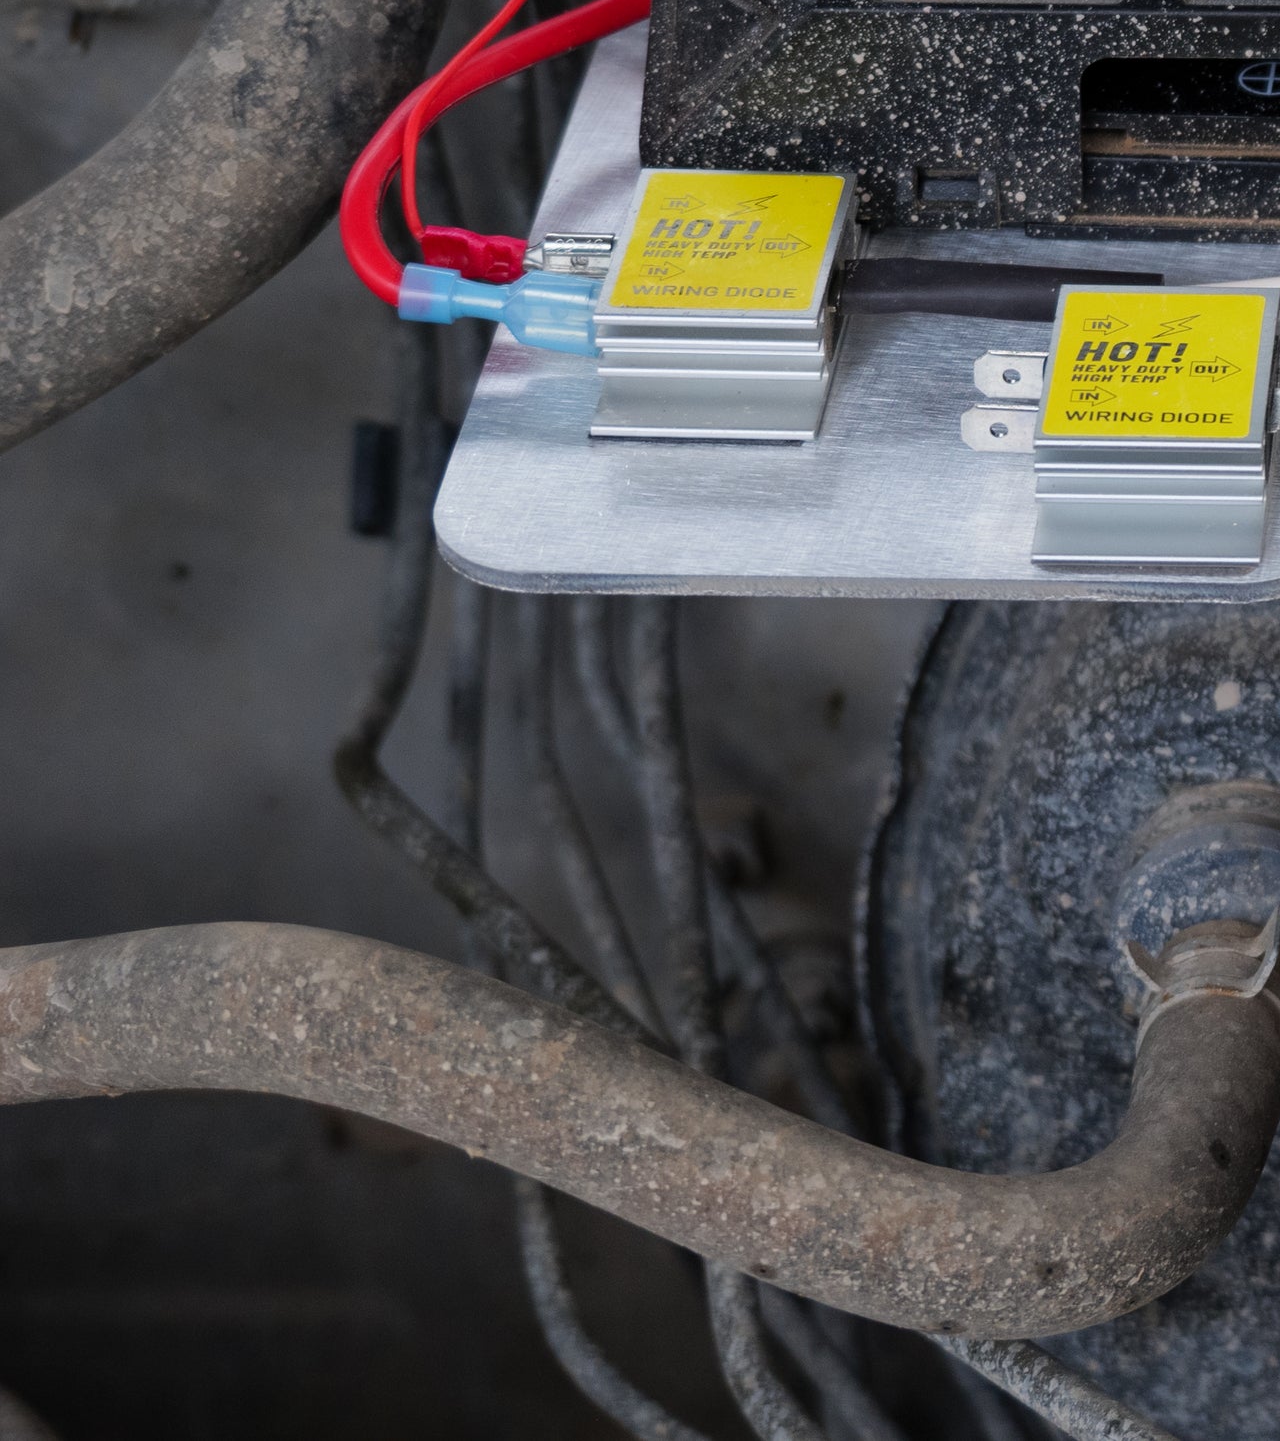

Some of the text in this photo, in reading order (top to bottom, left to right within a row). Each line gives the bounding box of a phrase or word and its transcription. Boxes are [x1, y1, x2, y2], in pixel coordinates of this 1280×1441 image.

[669, 201, 689, 209] IN
[650, 218, 762, 240] HOT!
[645, 240, 756, 250] HEAVY DUTY
[765, 242, 800, 251] OUT
[642, 250, 737, 259] HIGH TEMP
[648, 267, 669, 276] IN
[632, 285, 798, 299] WIRING DIODE
[1092, 321, 1112, 329] IN
[1075, 341, 1188, 363] HOT!
[1072, 364, 1185, 374] HEAVY DUTY
[1195, 365, 1230, 374] OUT
[1071, 374, 1168, 383] HIGH TEMP
[1079, 392, 1100, 400] IN
[1065, 410, 1234, 424] WIRING DIODE
